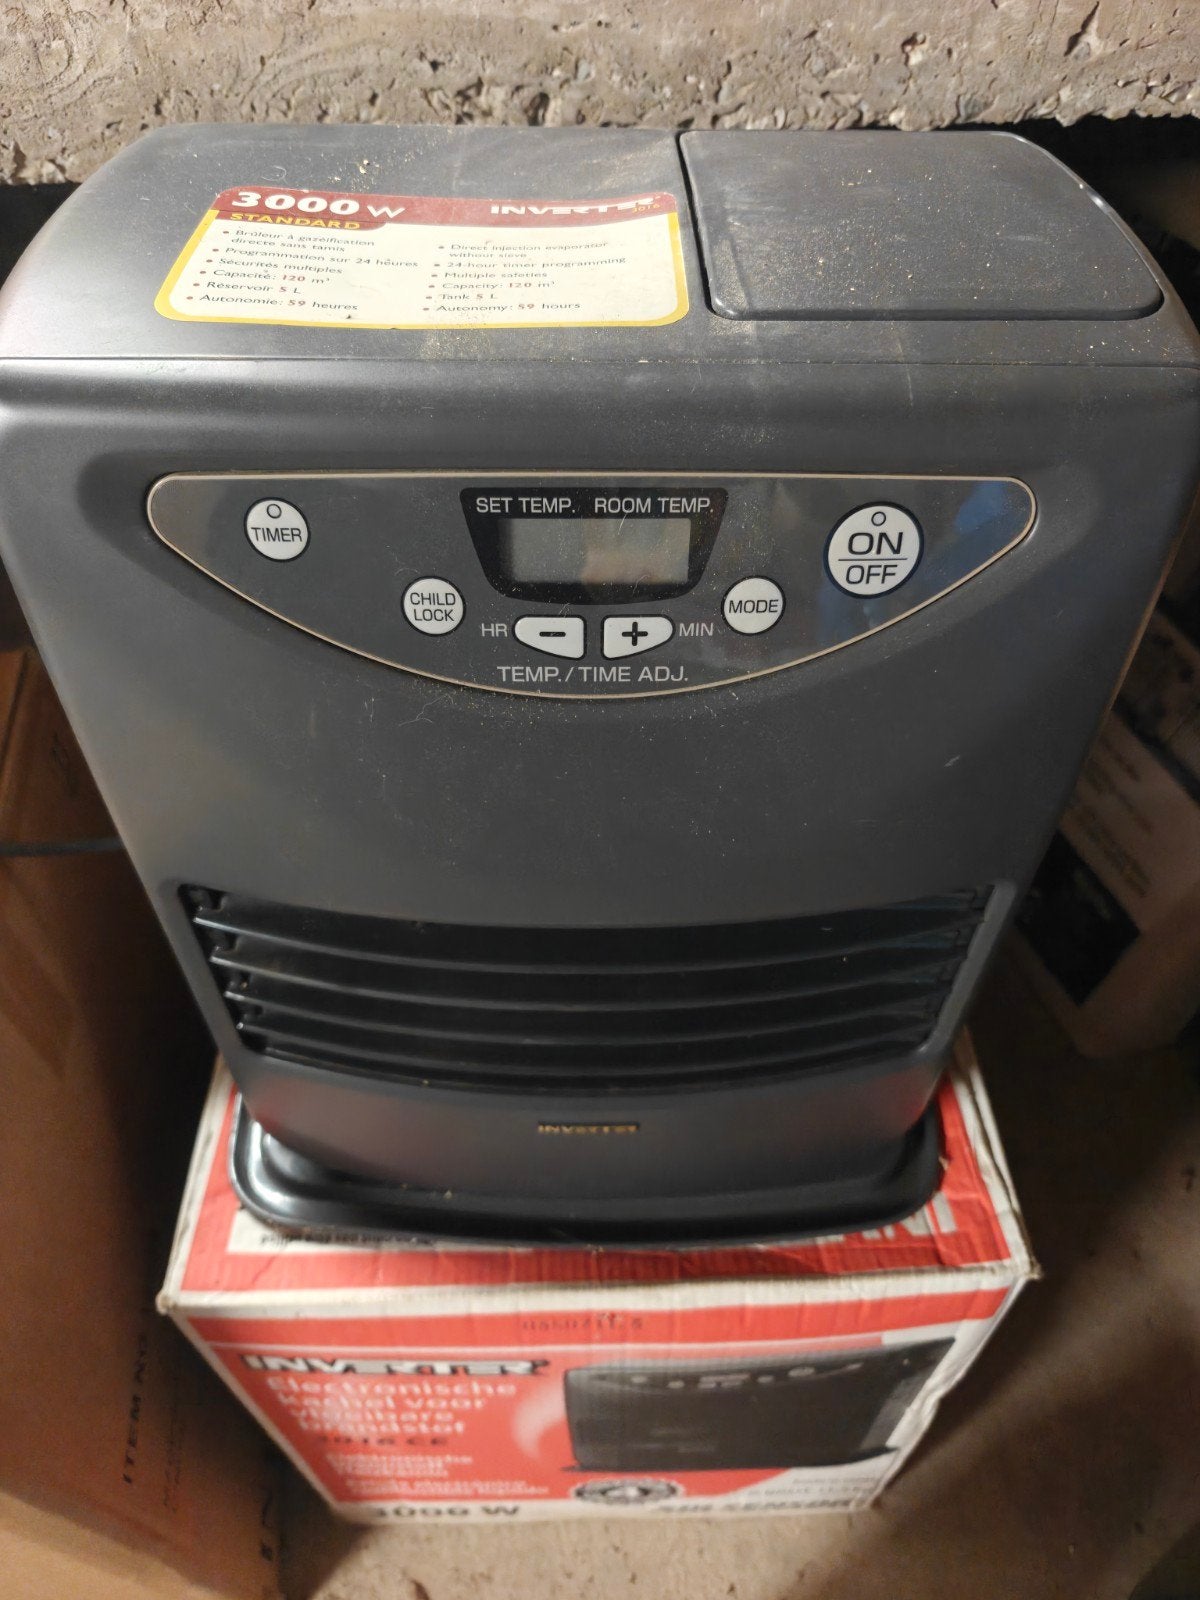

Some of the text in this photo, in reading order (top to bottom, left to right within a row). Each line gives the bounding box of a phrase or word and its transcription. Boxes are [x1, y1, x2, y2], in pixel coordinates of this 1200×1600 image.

[232, 191, 360, 215] 3000
[230, 212, 361, 230] STANDARD
[231, 237, 345, 252] directe sans tamis
[225, 247, 325, 262] Programmation
[219, 258, 343, 275] Sécurités multiples
[542, 257, 626, 269] programming
[282, 274, 306, 283] 120
[444, 272, 496, 280] Multiple
[206, 281, 274, 293] Réservoir
[293, 287, 302, 295] L
[442, 282, 504, 291] Capacity:
[199, 294, 360, 312] Autonomie: 59 heures
[439, 293, 471, 301] Tank
[436, 302, 582, 313] Autonomy: 59 hours
[475, 497, 576, 515] SET TEMP.
[594, 497, 714, 515] ROOM TEMP.
[250, 525, 303, 544] TIMER
[846, 531, 905, 556] ON
[844, 563, 898, 586] OFF
[409, 591, 457, 607] CHILD
[727, 598, 780, 616] MODE
[413, 607, 455, 623] LOCK
[480, 623, 508, 638] HR
[678, 622, 714, 637] MIN
[578, 666, 632, 682] TIME
[637, 666, 689, 683] ADJ.
